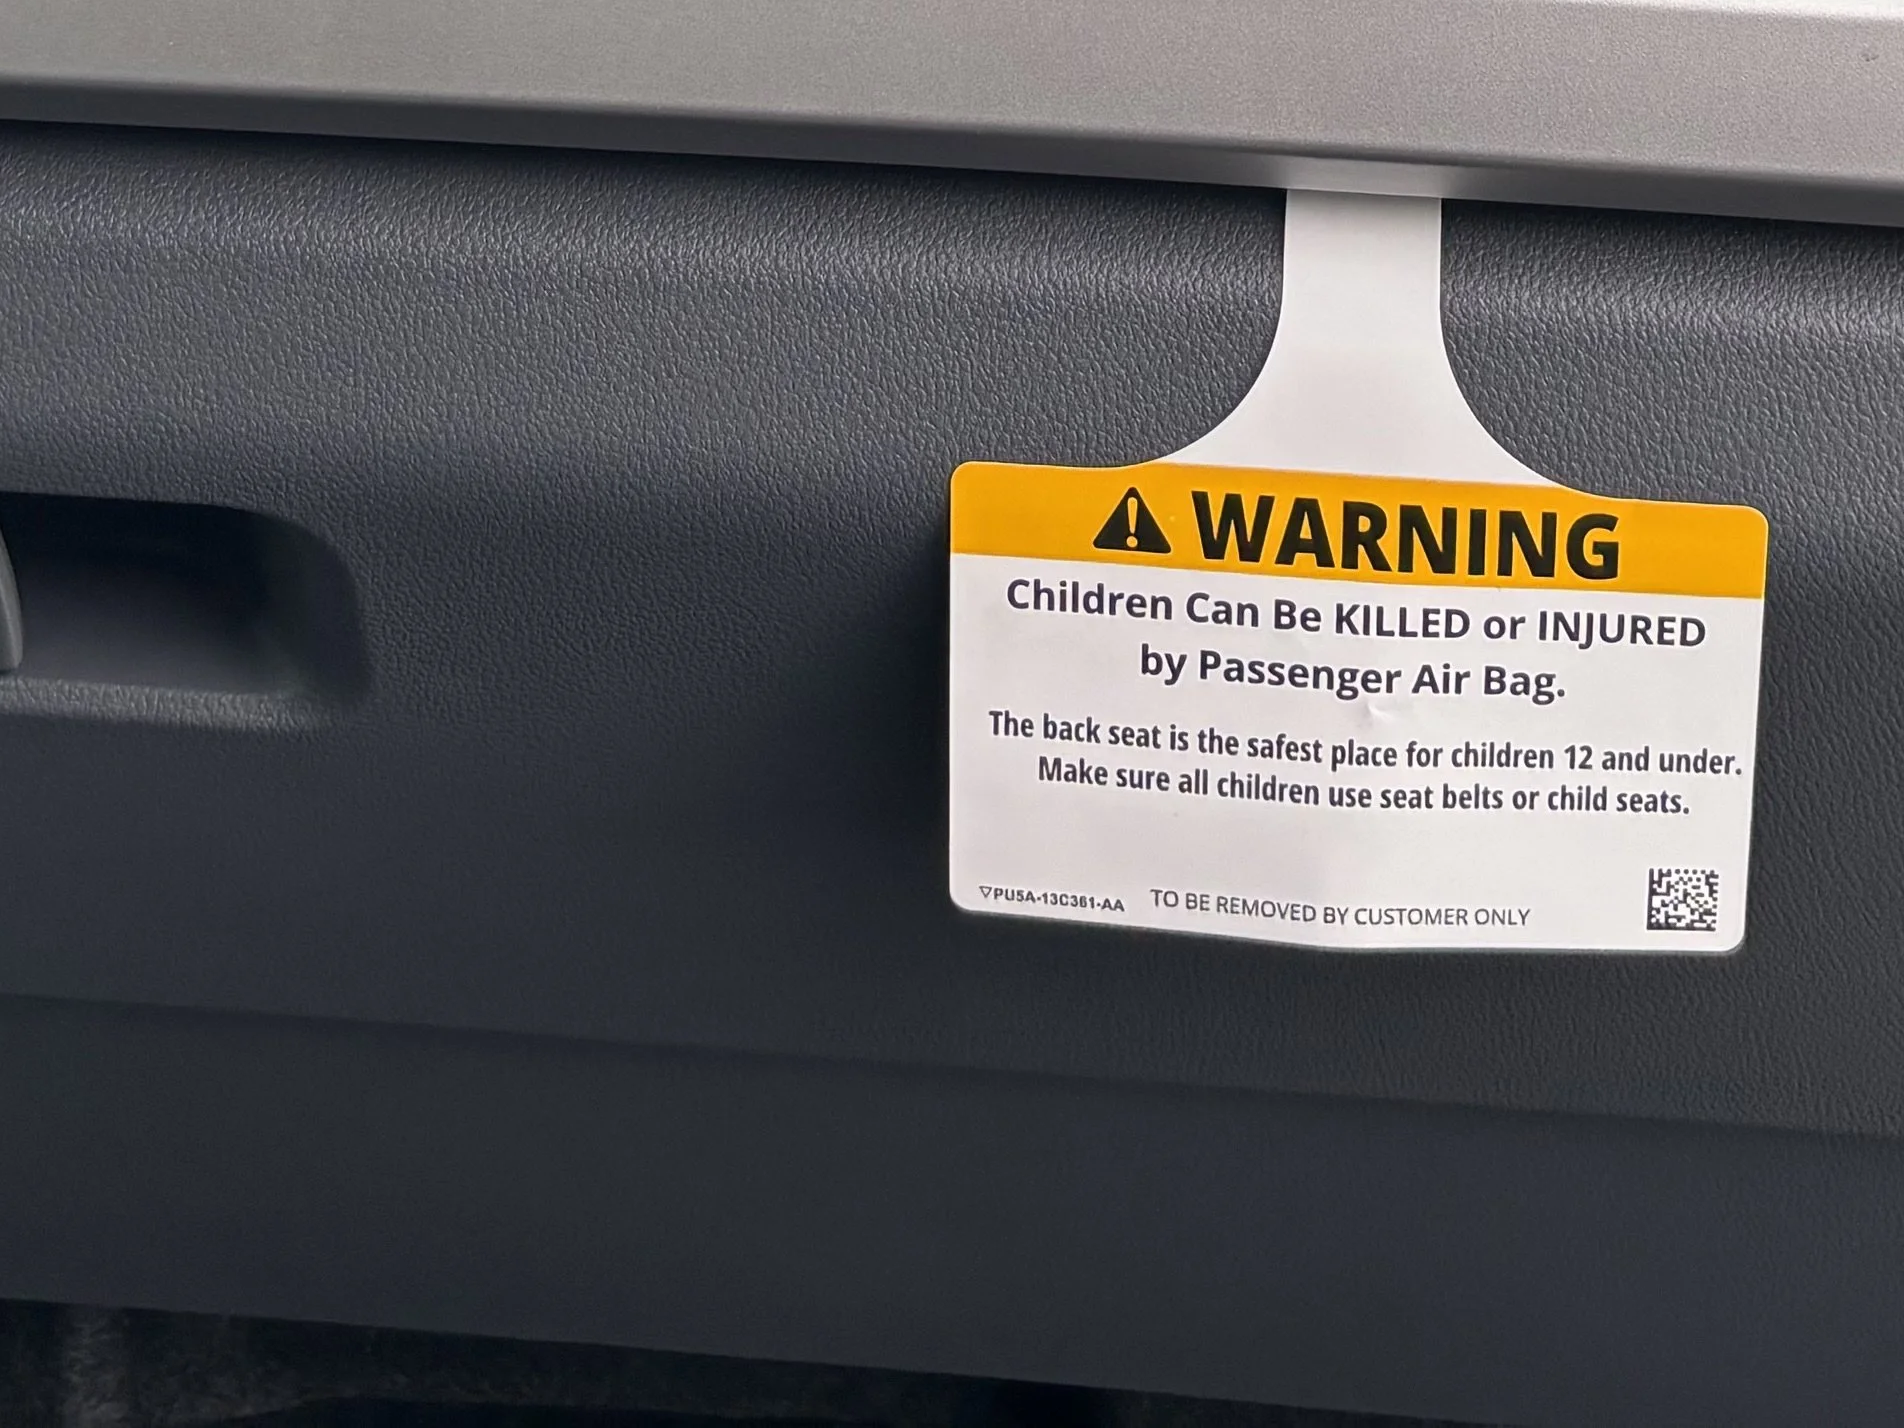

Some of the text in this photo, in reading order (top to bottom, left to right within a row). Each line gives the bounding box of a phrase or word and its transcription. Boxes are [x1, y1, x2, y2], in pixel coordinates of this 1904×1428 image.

[1191, 491, 1619, 580] WARNING
[1008, 579, 1705, 649] Children Can Be KILLED or INJURED
[1142, 643, 1565, 705] by Passenger Air Bag.
[989, 710, 1741, 775] The back seat is the safest place for children 12 and under.
[1039, 756, 1689, 814] Make sure all children use seat belts or child seats.
[1150, 889, 1530, 926] TO BE REMOVED BY CUSTOMER ONLY
